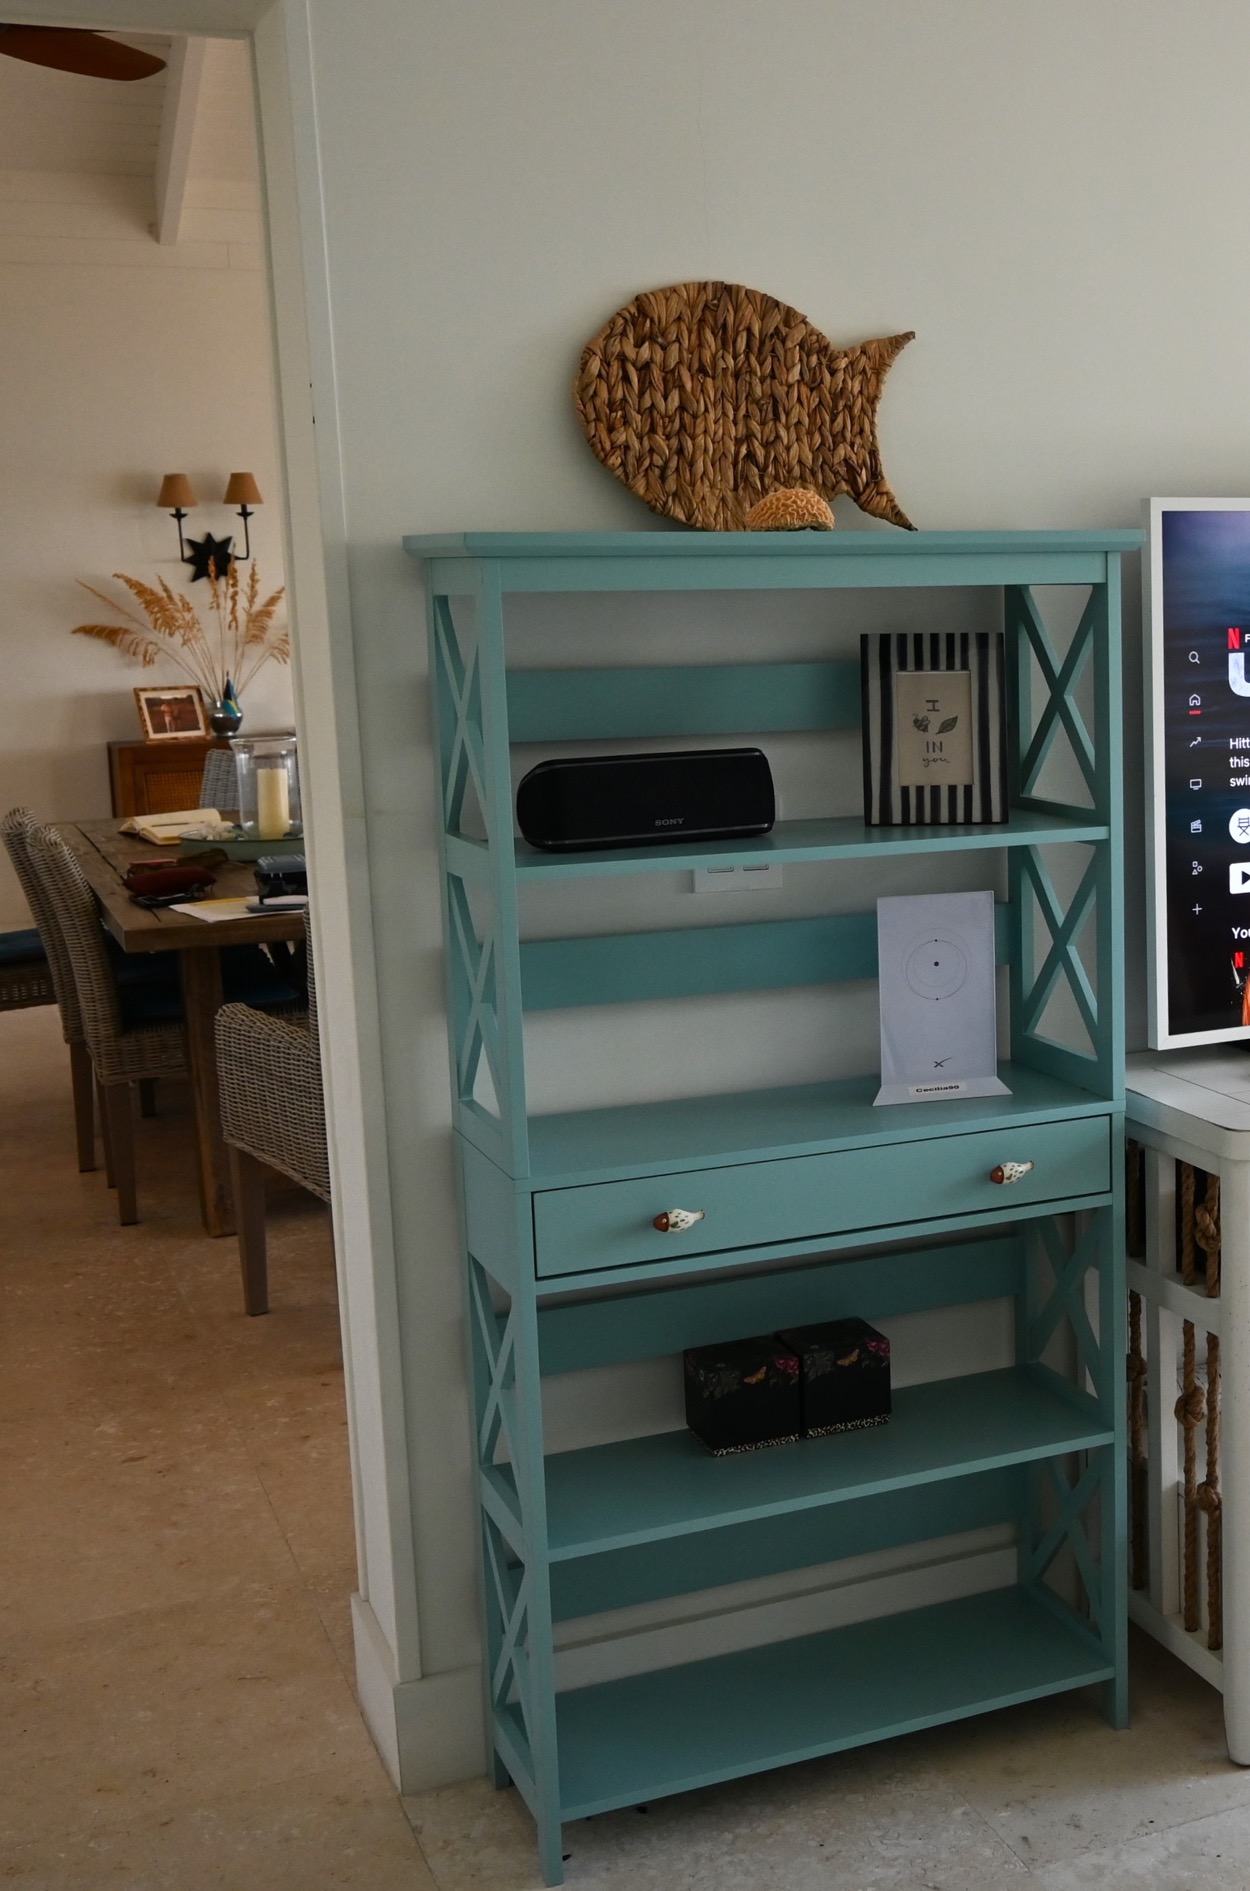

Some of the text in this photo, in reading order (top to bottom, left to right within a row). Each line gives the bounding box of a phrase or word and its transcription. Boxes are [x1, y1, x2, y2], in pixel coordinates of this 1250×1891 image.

[1228, 628, 1240, 649] N
[926, 741, 943, 753] IN
[1229, 756, 1250, 768] this
[654, 816, 685, 827] SONY
